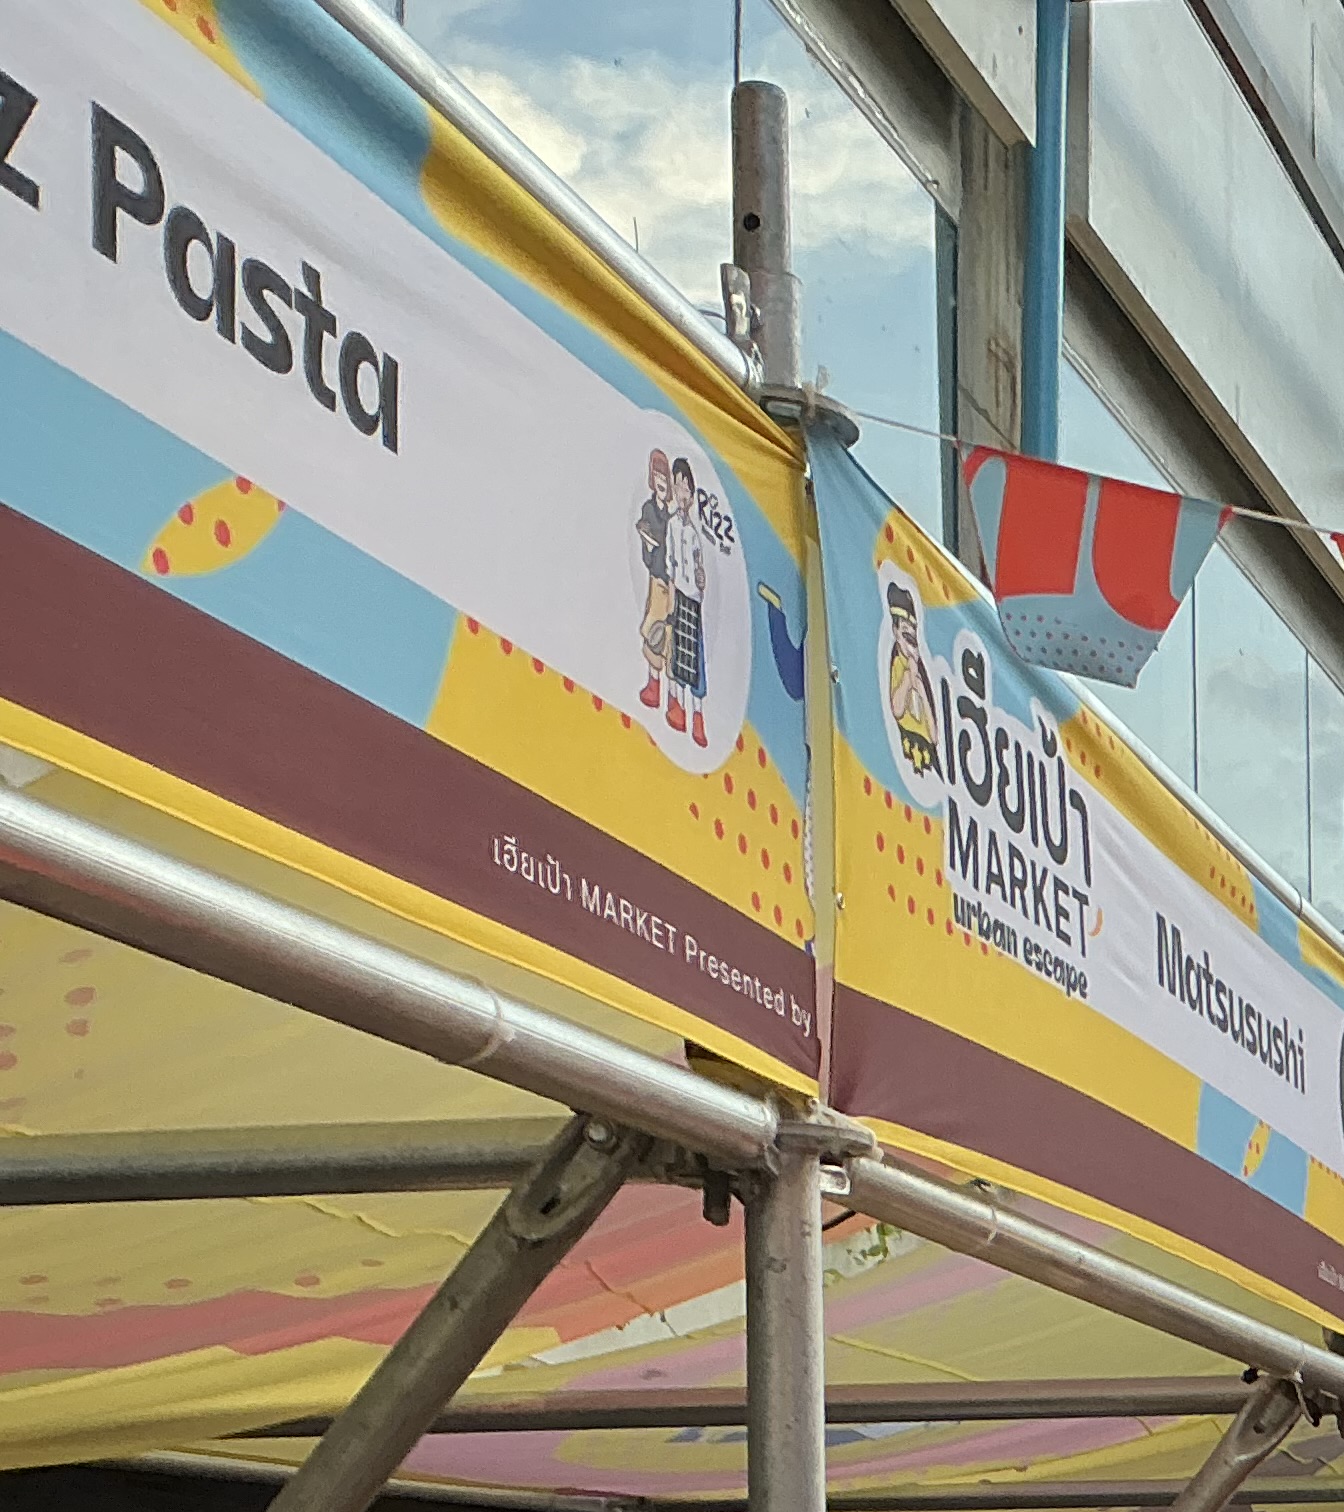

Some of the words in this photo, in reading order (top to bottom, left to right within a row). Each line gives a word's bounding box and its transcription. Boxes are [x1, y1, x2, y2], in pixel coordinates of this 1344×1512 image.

[90, 100, 399, 456] Pasta
[580, 877, 677, 954] MARKET
[684, 933, 785, 1017] Presented
[790, 994, 813, 1037] by
[947, 794, 1089, 959] MARKET
[952, 892, 1018, 956] urban
[1022, 935, 1088, 999] escape
[1156, 911, 1305, 1095] Matsusushi
